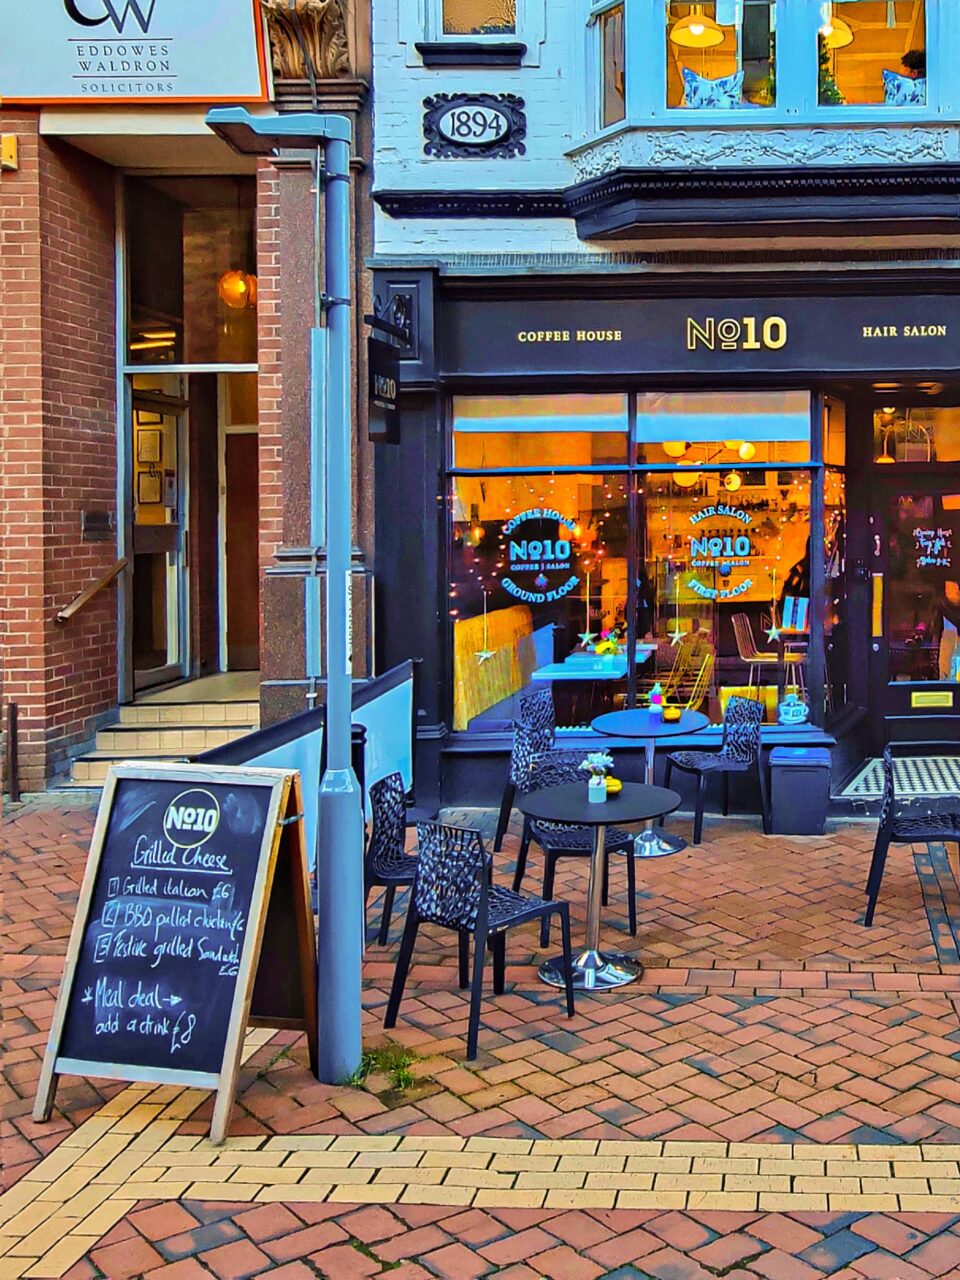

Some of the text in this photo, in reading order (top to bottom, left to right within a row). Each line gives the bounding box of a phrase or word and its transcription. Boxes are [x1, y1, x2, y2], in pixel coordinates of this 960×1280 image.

[76, 45, 169, 57] EDDOWES
[78, 60, 171, 72] WALDRON
[80, 82, 174, 93] SOLICITORS
[450, 110, 502, 138] 1894
[517, 330, 622, 342] COFFEE HOUSE
[862, 325, 947, 338] HAIR SALON
[503, 508, 577, 535] COFFEE HOUSE
[690, 504, 752, 525] HAIR SALON
[510, 562, 571, 571] COFFEE SALON
[501, 575, 580, 603] GROUND FLOOR
[719, 578, 753, 598] FLOOR
[133, 834, 230, 871] Grilled Cheese
[122, 876, 158, 896] Grilled
[163, 877, 209, 899] italian
[211, 881, 233, 901] £6
[113, 929, 148, 959] Festive
[150, 934, 195, 969] grilled
[94, 976, 162, 1009] Meal deal
[95, 1012, 119, 1035] add
[127, 1018, 138, 1032] a
[139, 1014, 169, 1036] drink
